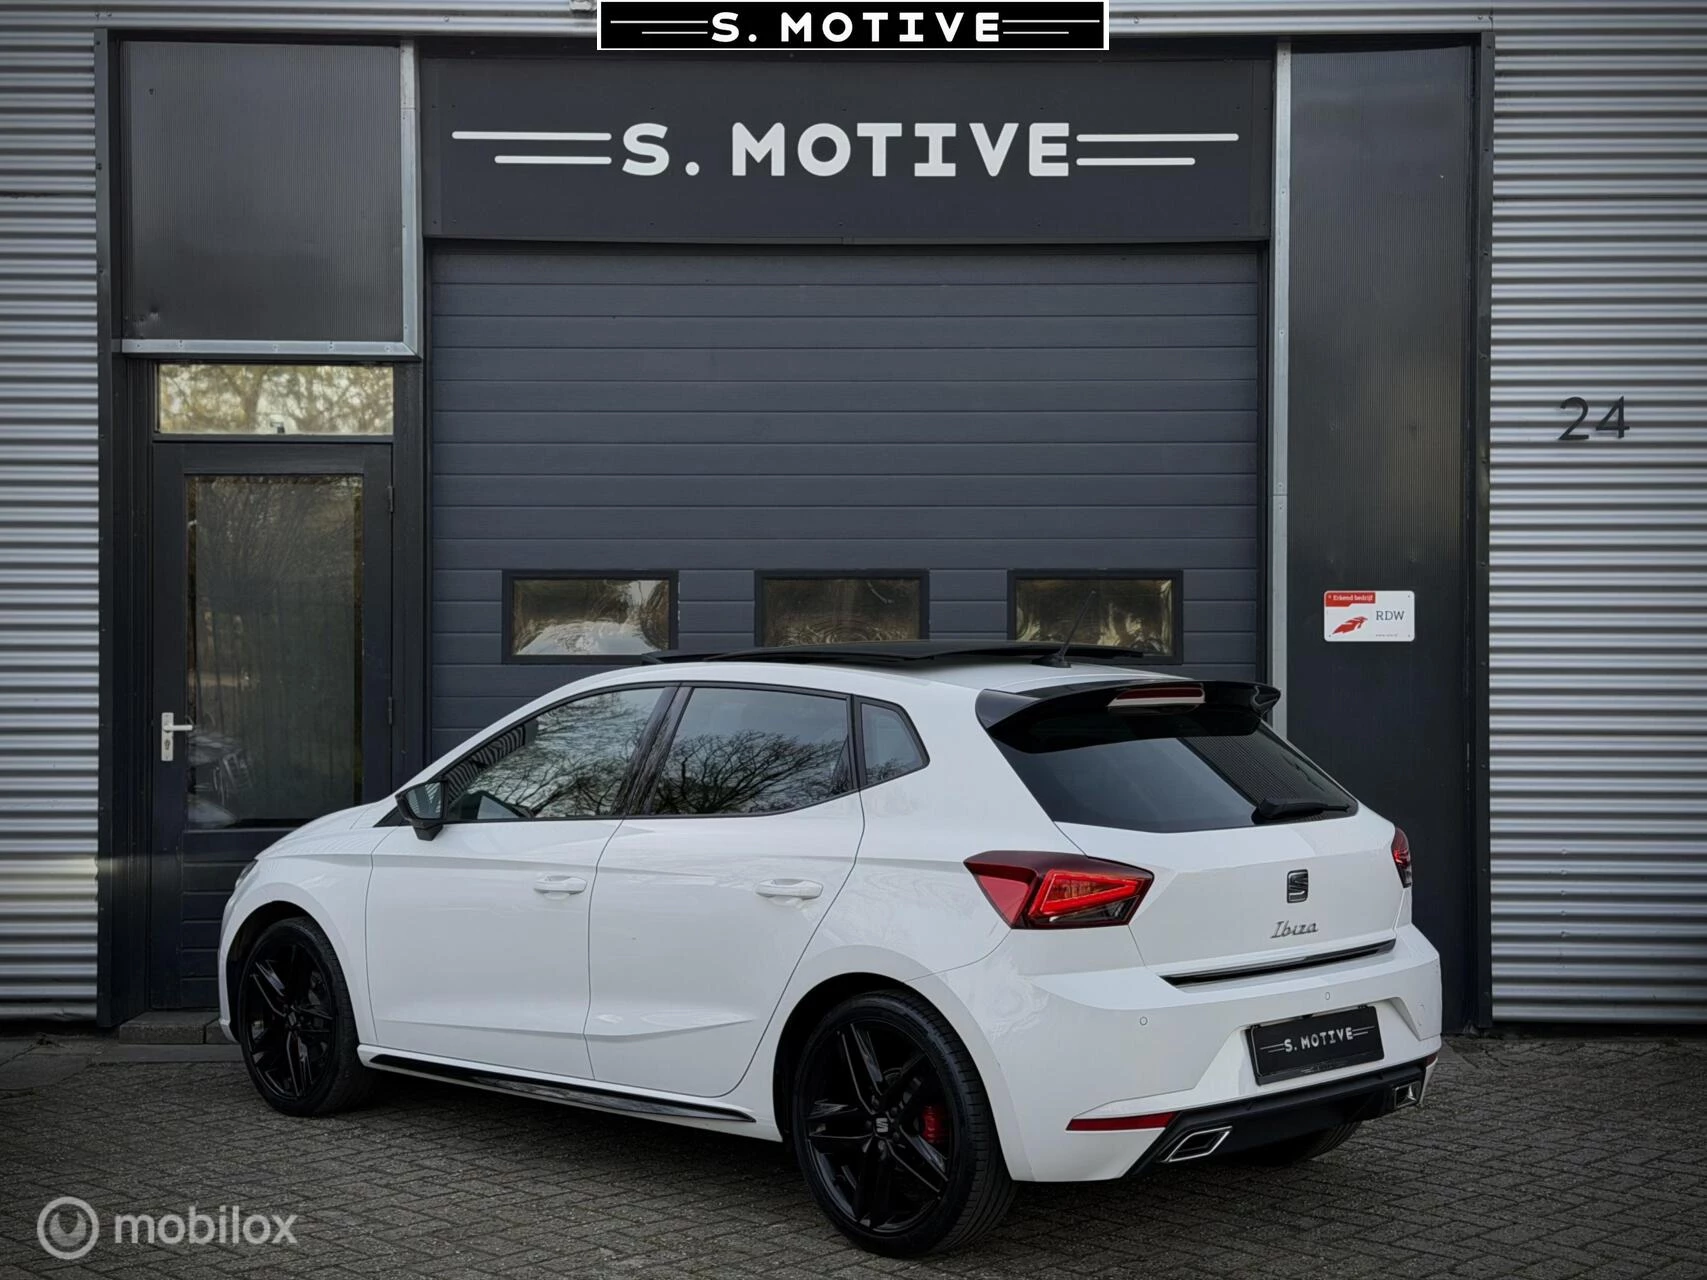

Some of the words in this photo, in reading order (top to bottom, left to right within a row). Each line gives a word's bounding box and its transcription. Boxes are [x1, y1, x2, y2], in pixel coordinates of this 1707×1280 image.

[622, 122, 700, 176] S.
[731, 122, 1070, 177] MOTIVE
[1558, 395, 1631, 441] 24
[1375, 610, 1405, 621] RDW
[1270, 920, 1319, 939] Ibiza
[1284, 1038, 1298, 1052] S.
[1300, 1027, 1354, 1050] MOTIVE
